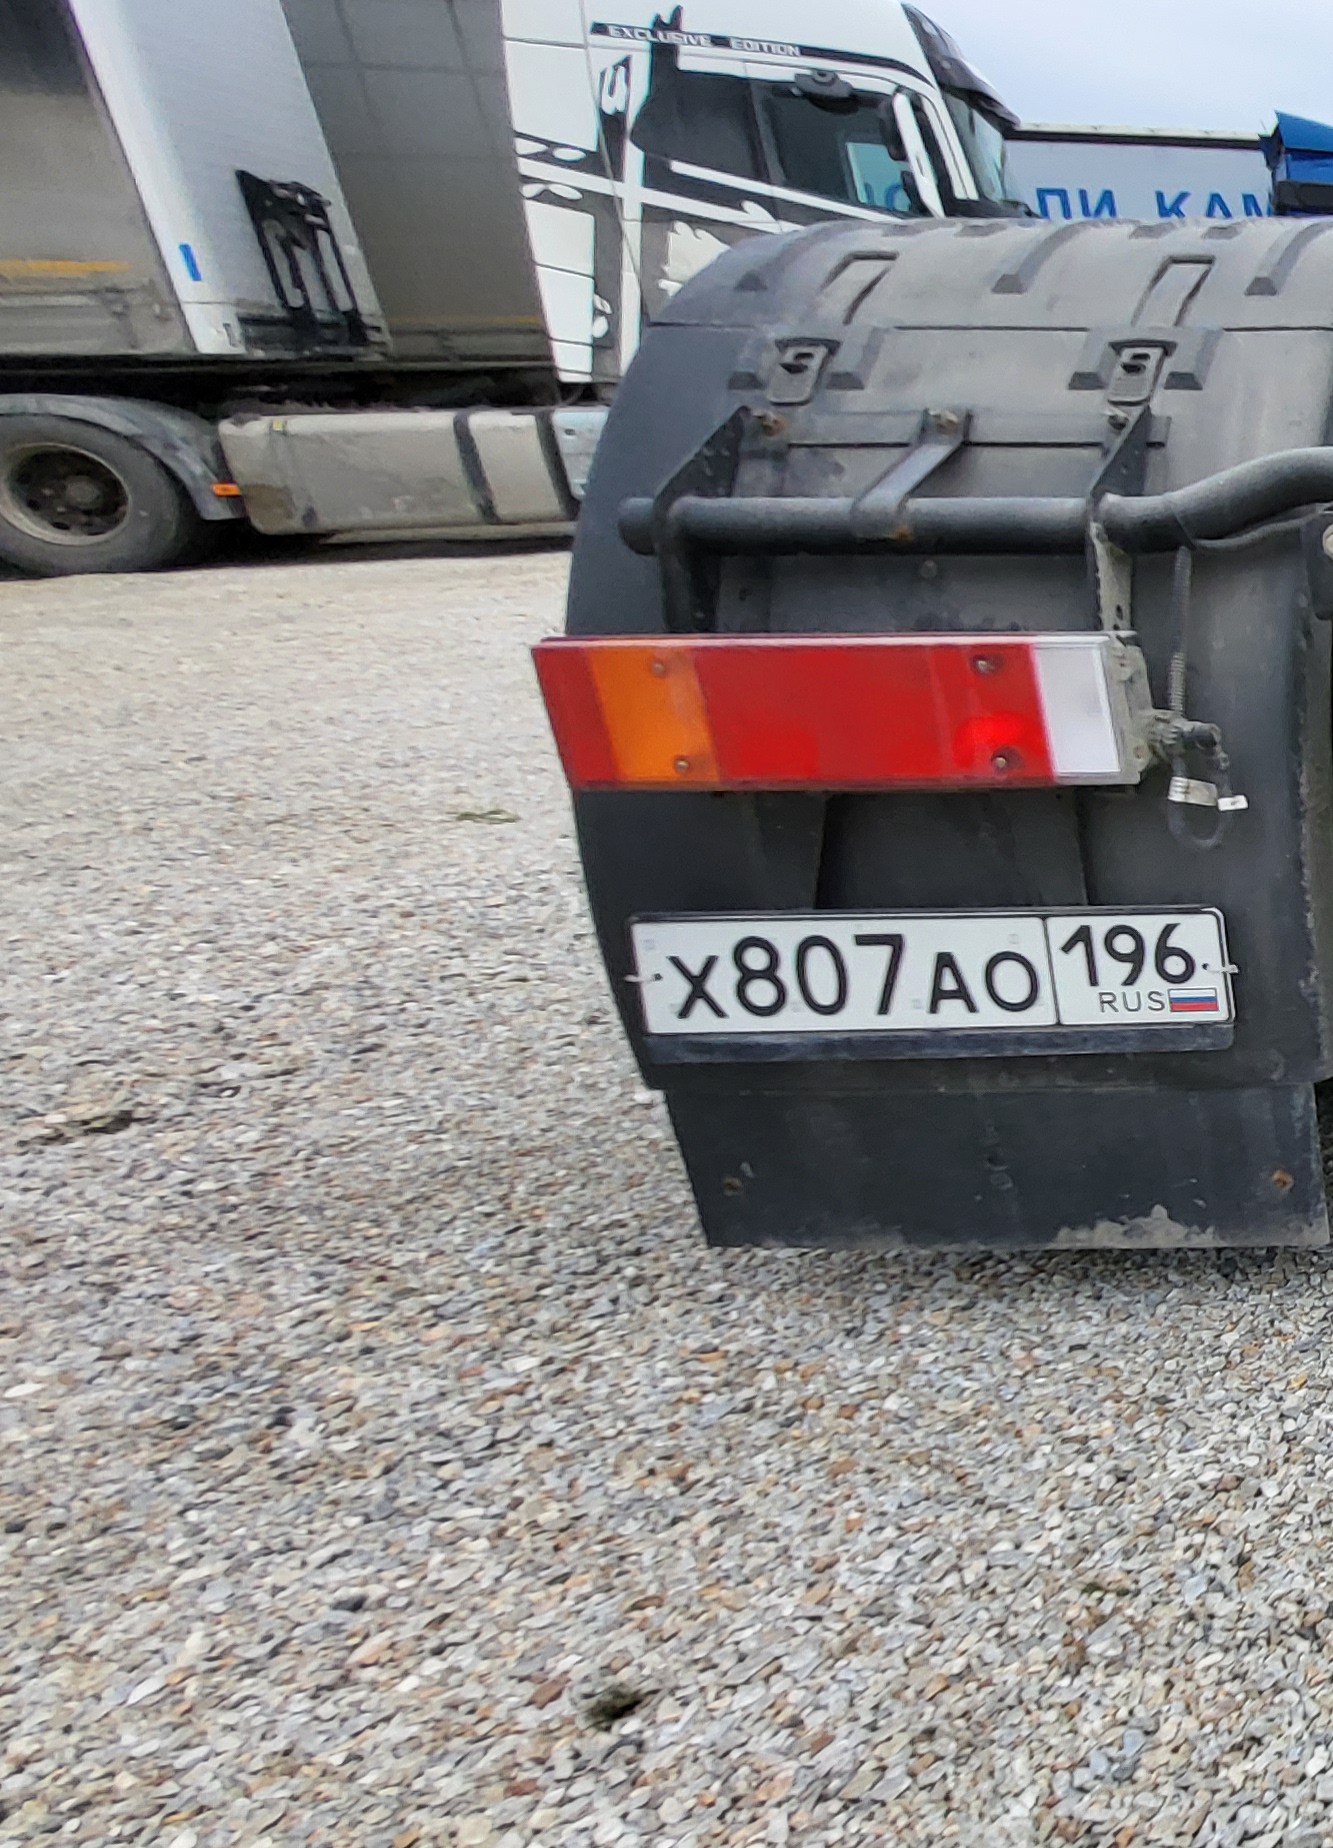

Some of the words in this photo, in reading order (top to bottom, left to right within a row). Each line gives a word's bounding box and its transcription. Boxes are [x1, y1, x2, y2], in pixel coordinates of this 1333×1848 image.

[609, 25, 711, 47] EXCLUSIVE
[729, 37, 800, 57] EDITION
[1061, 922, 1196, 989] 196
[1100, 991, 1165, 1015] RUS
